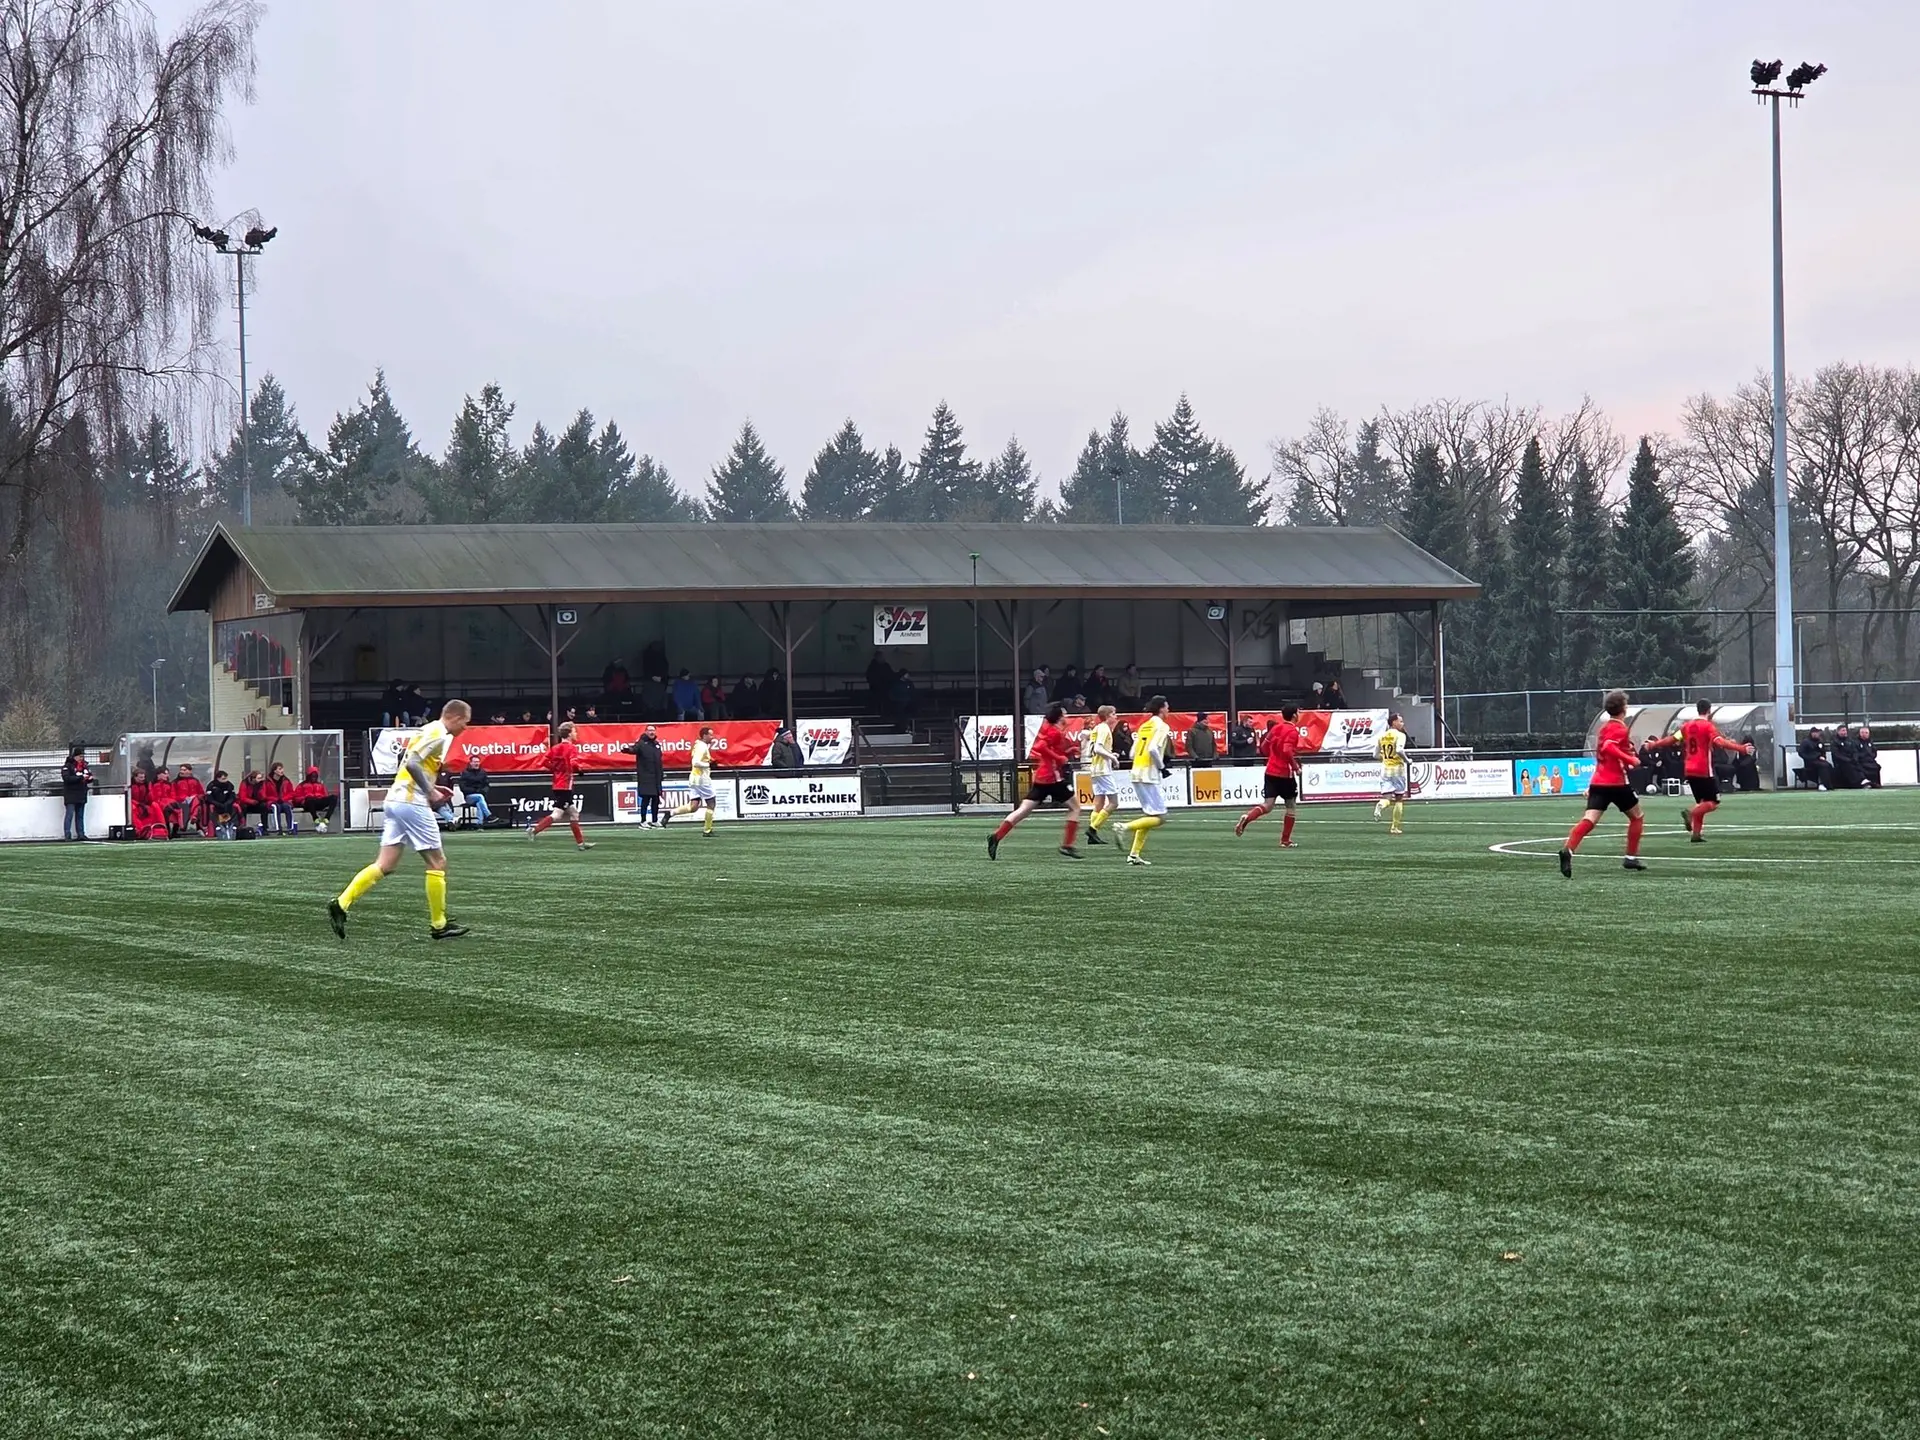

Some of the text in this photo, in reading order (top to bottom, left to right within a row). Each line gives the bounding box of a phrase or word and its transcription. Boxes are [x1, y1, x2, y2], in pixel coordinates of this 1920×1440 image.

[884, 606, 927, 644] VDZ
[462, 742, 517, 755] Voetbal
[519, 743, 547, 754] met
[656, 739, 691, 751] inds
[1382, 743, 1394, 759] 12
[1435, 764, 1466, 787] Denzo
[809, 783, 823, 793] RJ
[1079, 788, 1096, 804] bv
[1195, 785, 1219, 800] bvr
[1224, 785, 1266, 799] advie
[510, 794, 584, 813] Merkij
[624, 793, 635, 804] de
[772, 793, 857, 805] LASTECHNIEK
